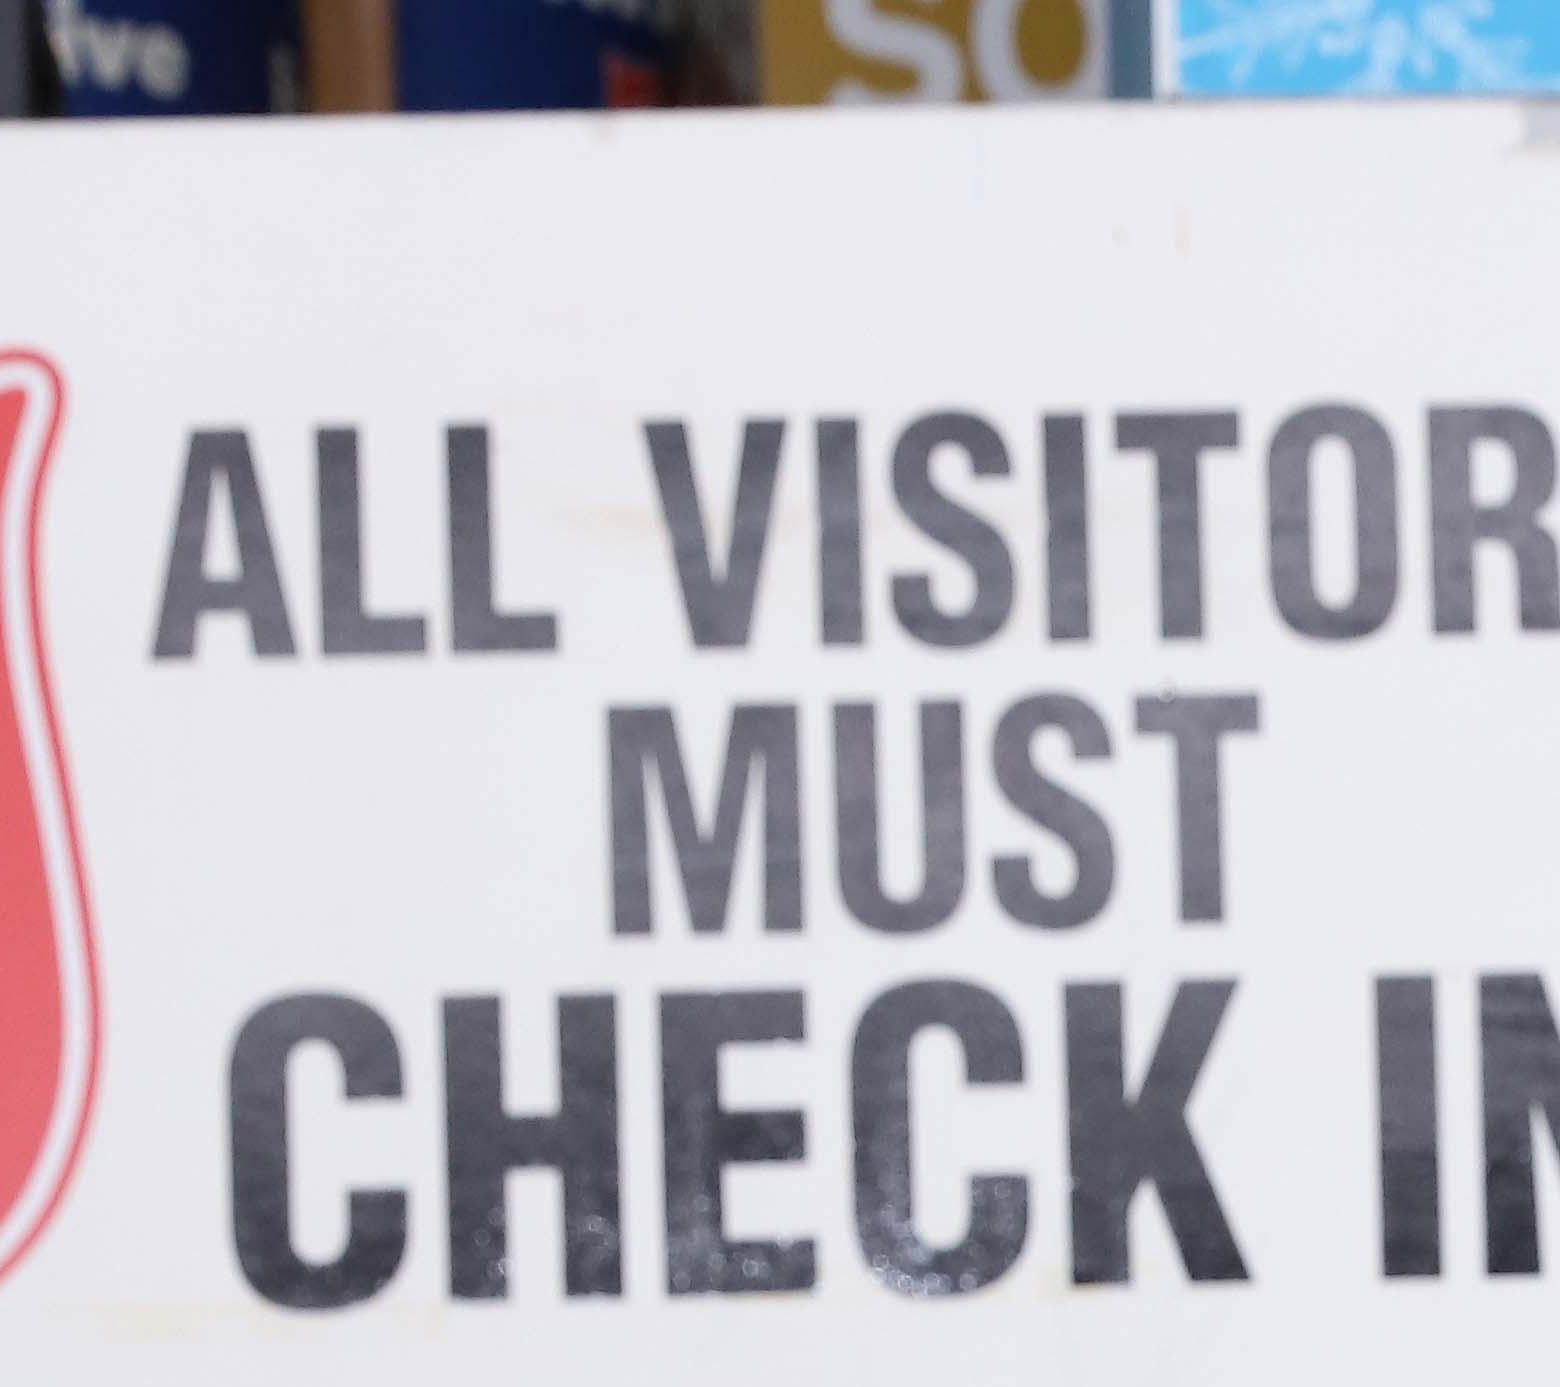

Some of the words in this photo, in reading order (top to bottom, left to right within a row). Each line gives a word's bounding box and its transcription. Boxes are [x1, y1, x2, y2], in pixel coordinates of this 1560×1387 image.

[150, 422, 560, 662] ALL
[606, 688, 1262, 938] MUST
[226, 972, 1252, 1311] CHECK
